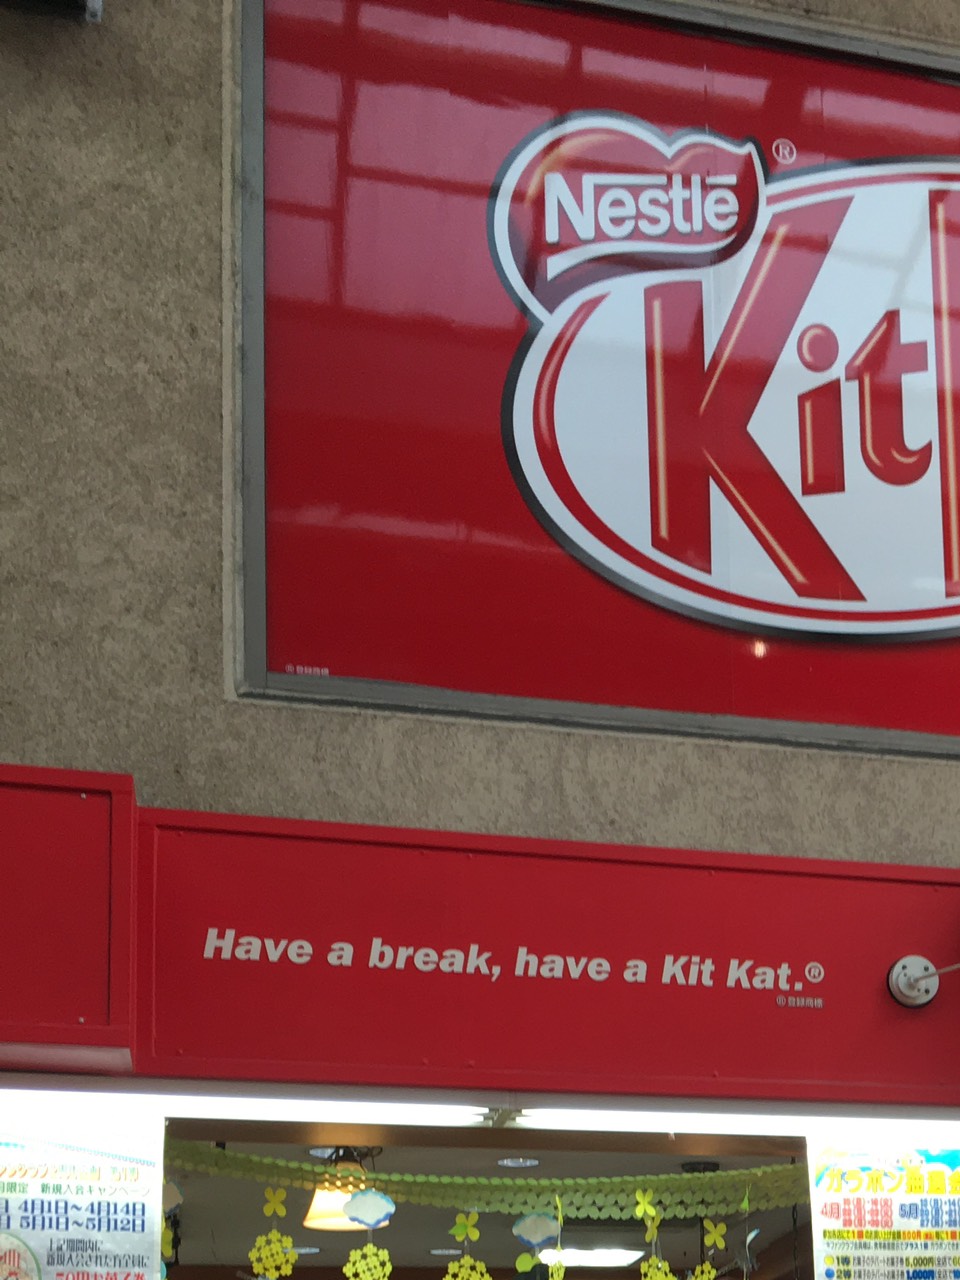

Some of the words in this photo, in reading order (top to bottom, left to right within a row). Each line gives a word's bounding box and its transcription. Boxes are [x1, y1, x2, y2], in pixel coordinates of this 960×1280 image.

[203, 927, 313, 967] Have
[328, 939, 354, 968] a
[367, 936, 502, 982] break,
[514, 945, 612, 983] have
[624, 957, 648, 984] a
[662, 954, 714, 988] Kit
